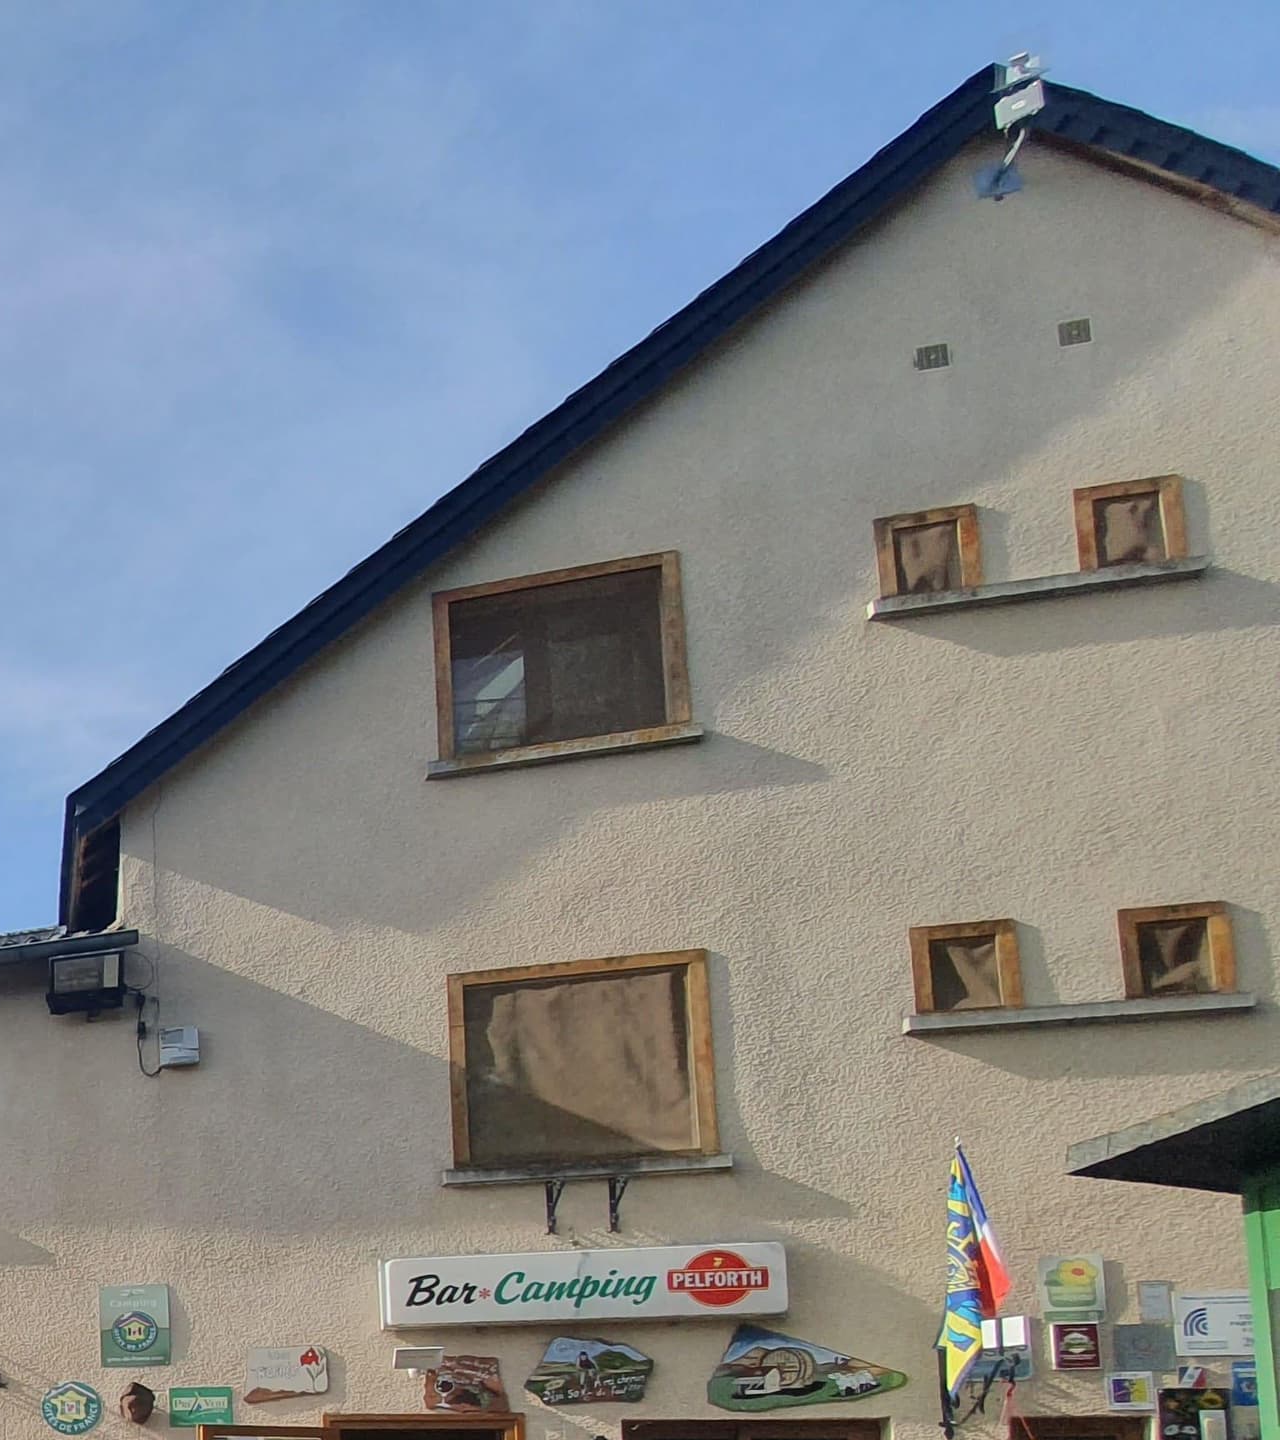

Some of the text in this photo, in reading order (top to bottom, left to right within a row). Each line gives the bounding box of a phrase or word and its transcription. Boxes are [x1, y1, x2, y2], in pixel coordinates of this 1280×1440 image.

[406, 1270, 657, 1308] Bar Camping
[672, 1271, 764, 1288] PELFORTH
[73, 1403, 98, 1431] FRANCE
